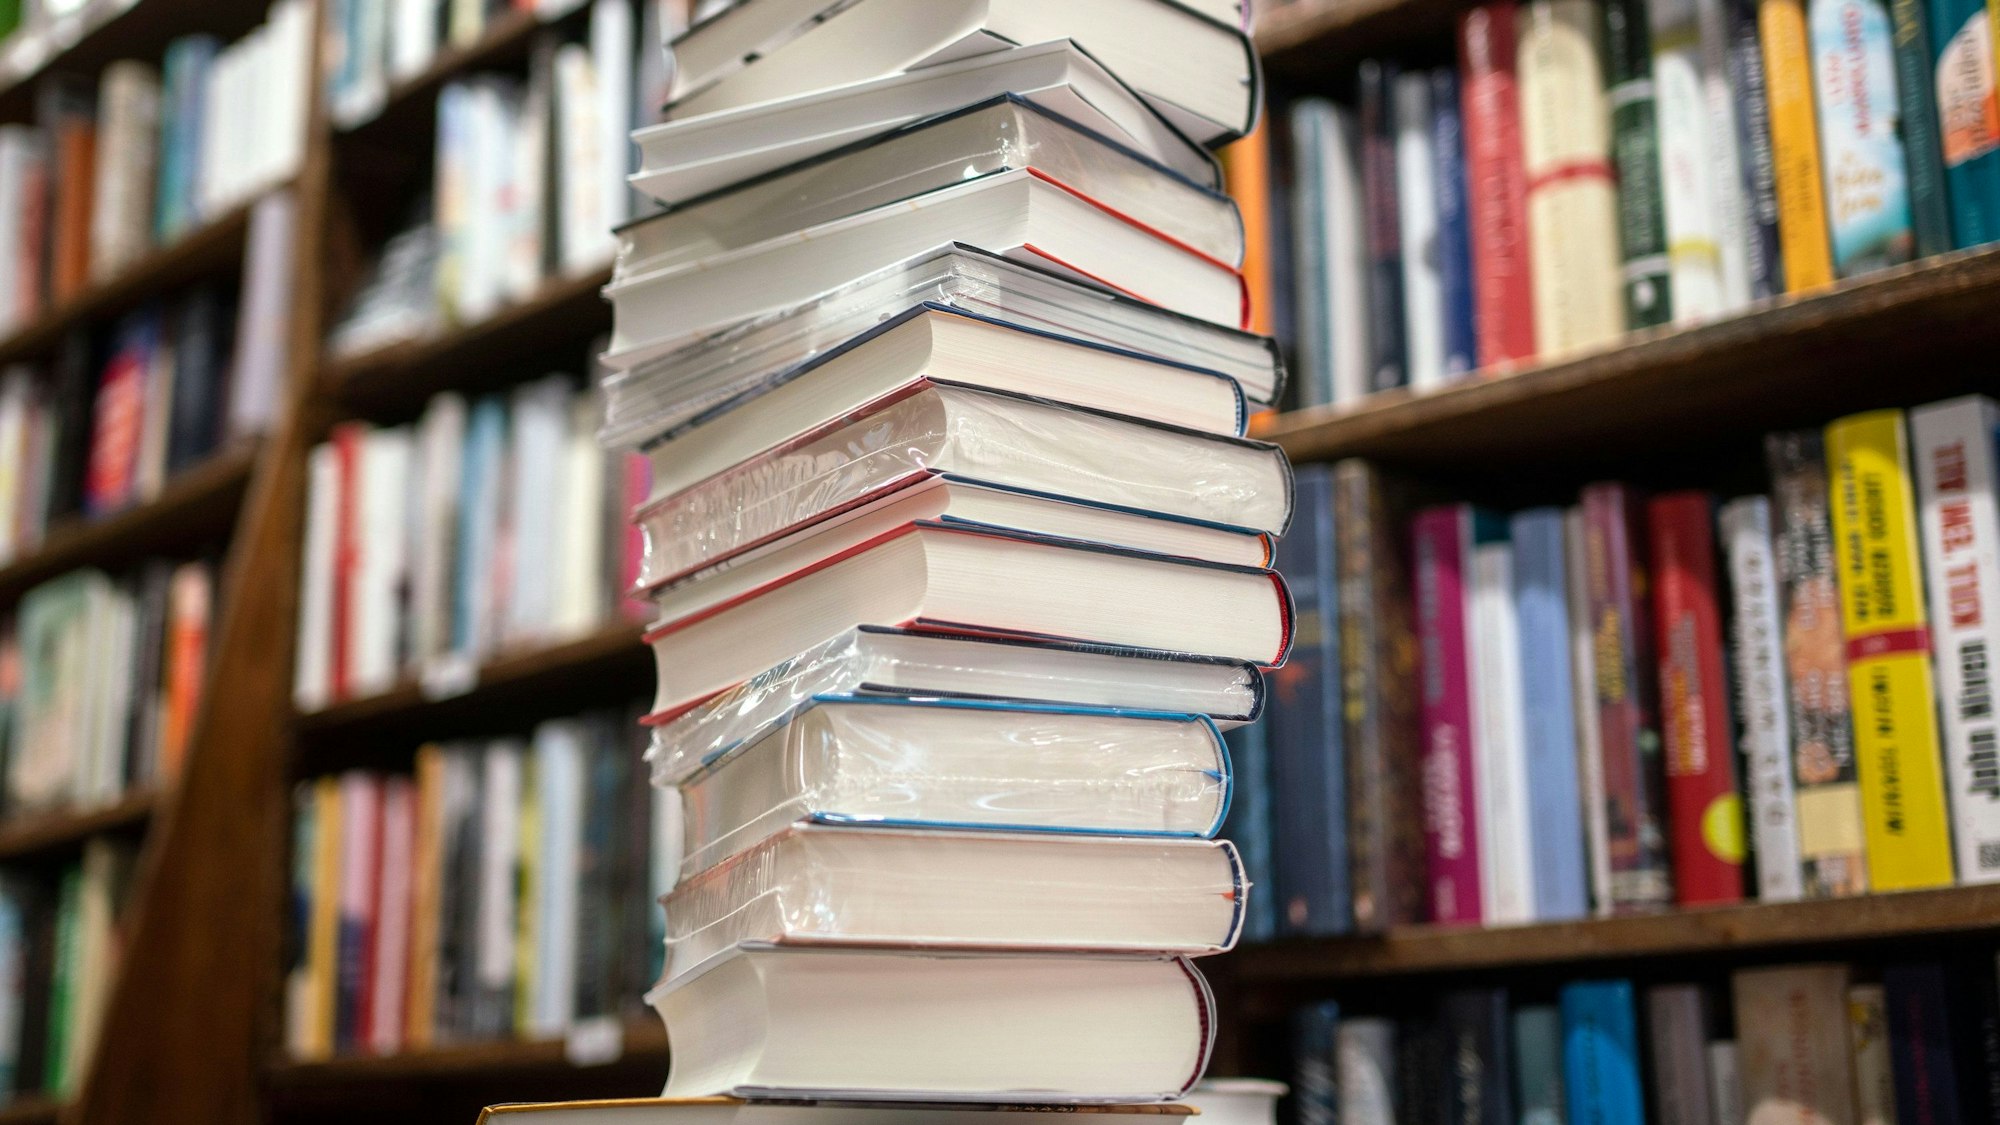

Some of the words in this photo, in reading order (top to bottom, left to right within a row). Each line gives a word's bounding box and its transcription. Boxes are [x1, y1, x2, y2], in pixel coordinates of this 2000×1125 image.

[1932, 438, 1968, 493] ALL
[1946, 561, 1983, 629] KILL
[1959, 638, 1993, 721] Niven
[1965, 729, 2000, 802] John
